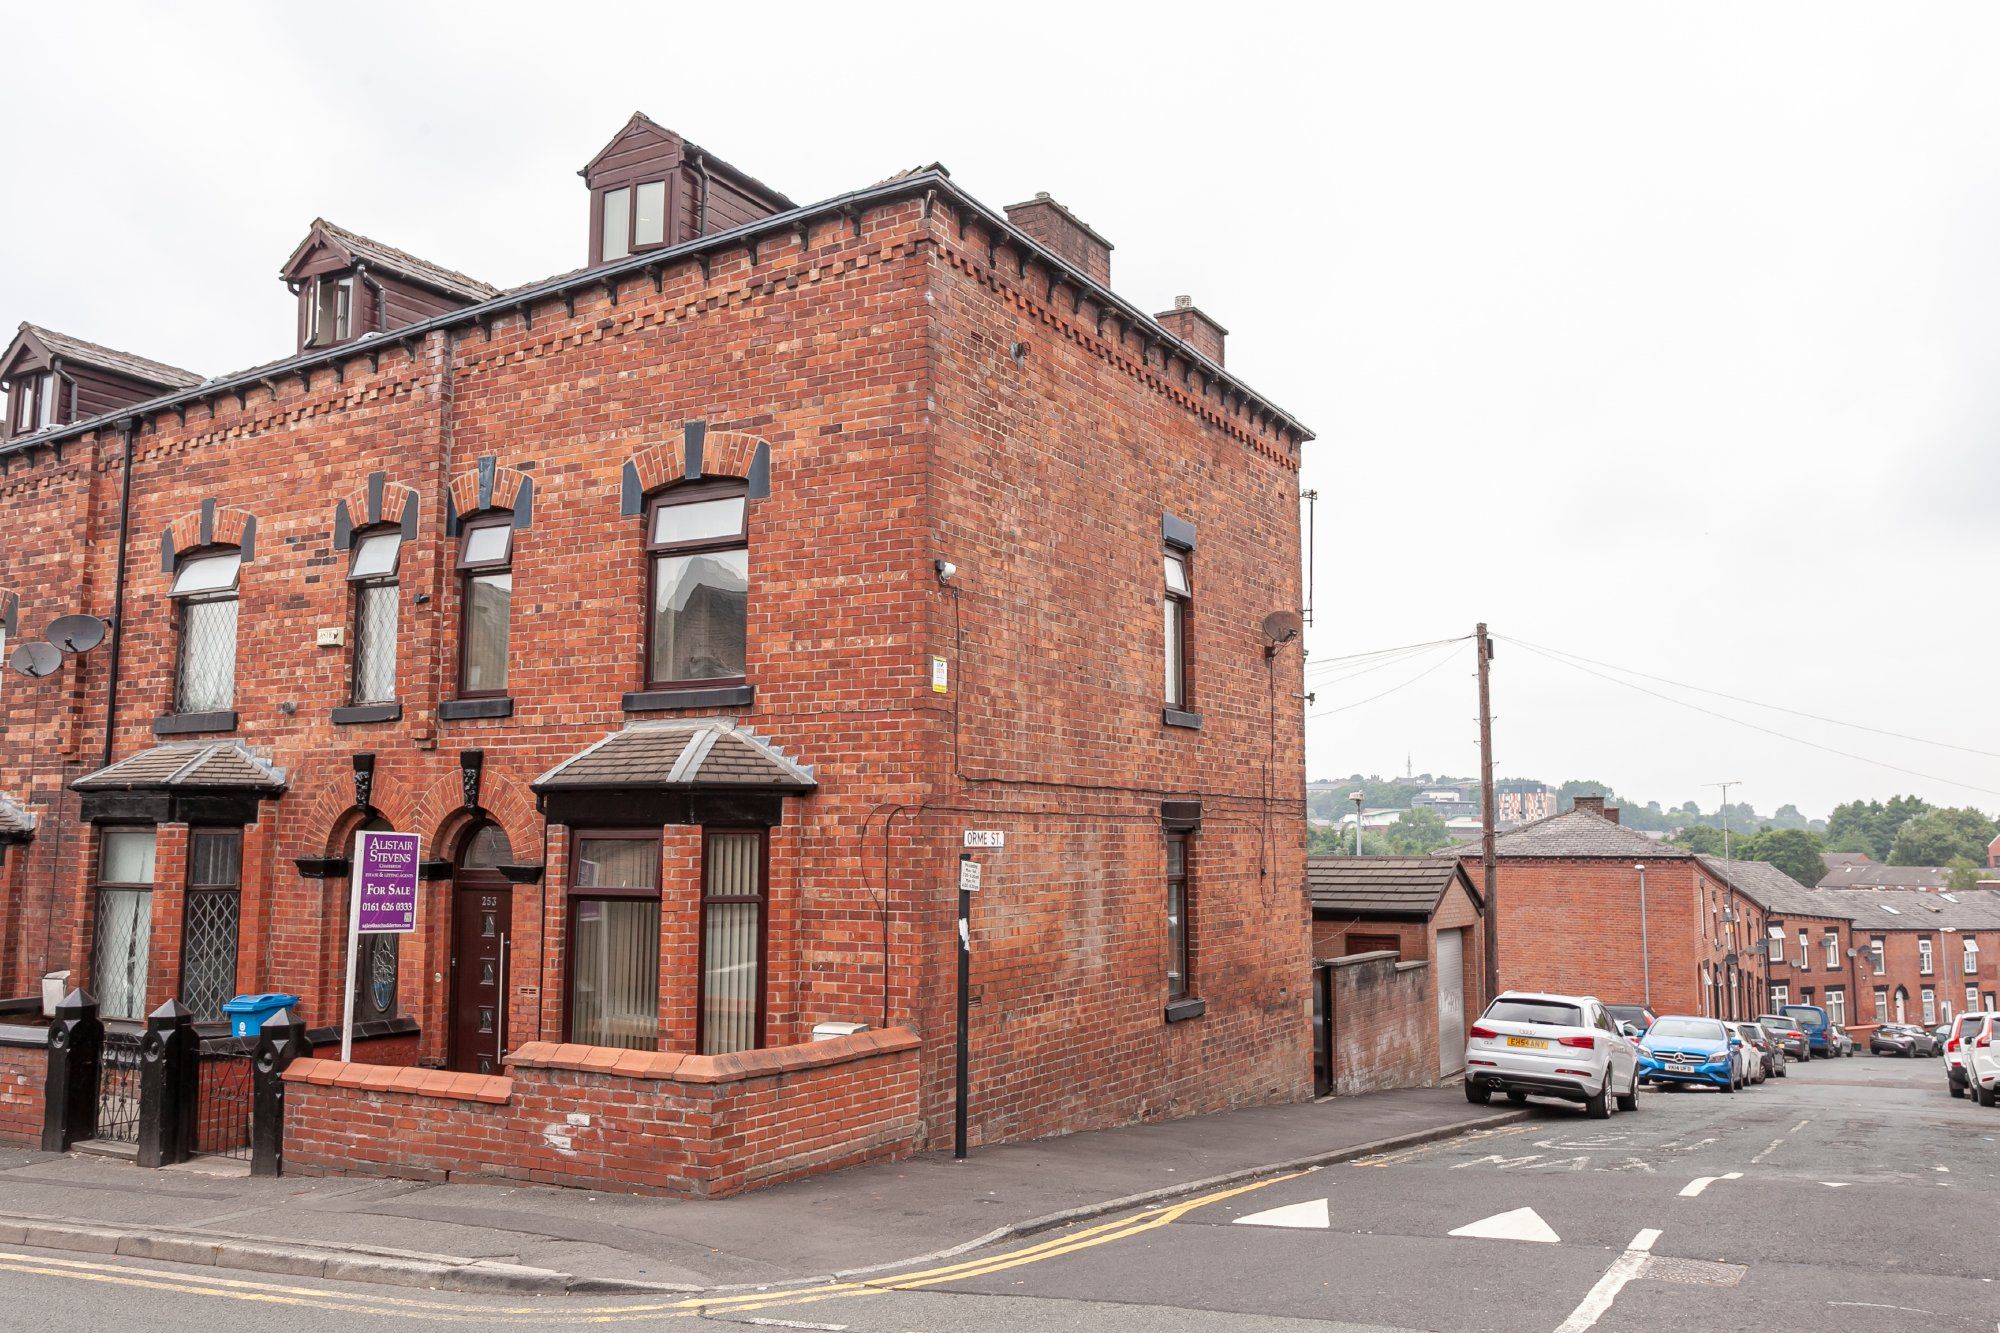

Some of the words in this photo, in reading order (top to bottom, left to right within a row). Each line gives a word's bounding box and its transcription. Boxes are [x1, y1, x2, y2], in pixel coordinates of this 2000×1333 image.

[370, 837, 413, 851] ALISTAIR
[967, 832, 988, 845] ORME
[990, 832, 1002, 845] ST.
[370, 850, 411, 863] STEVENS
[367, 883, 386, 895] FOR
[388, 883, 411, 895] SALE
[362, 902, 380, 912] 0161
[381, 902, 394, 912] 626
[395, 902, 413, 912] 0333
[482, 896, 497, 906] 253
